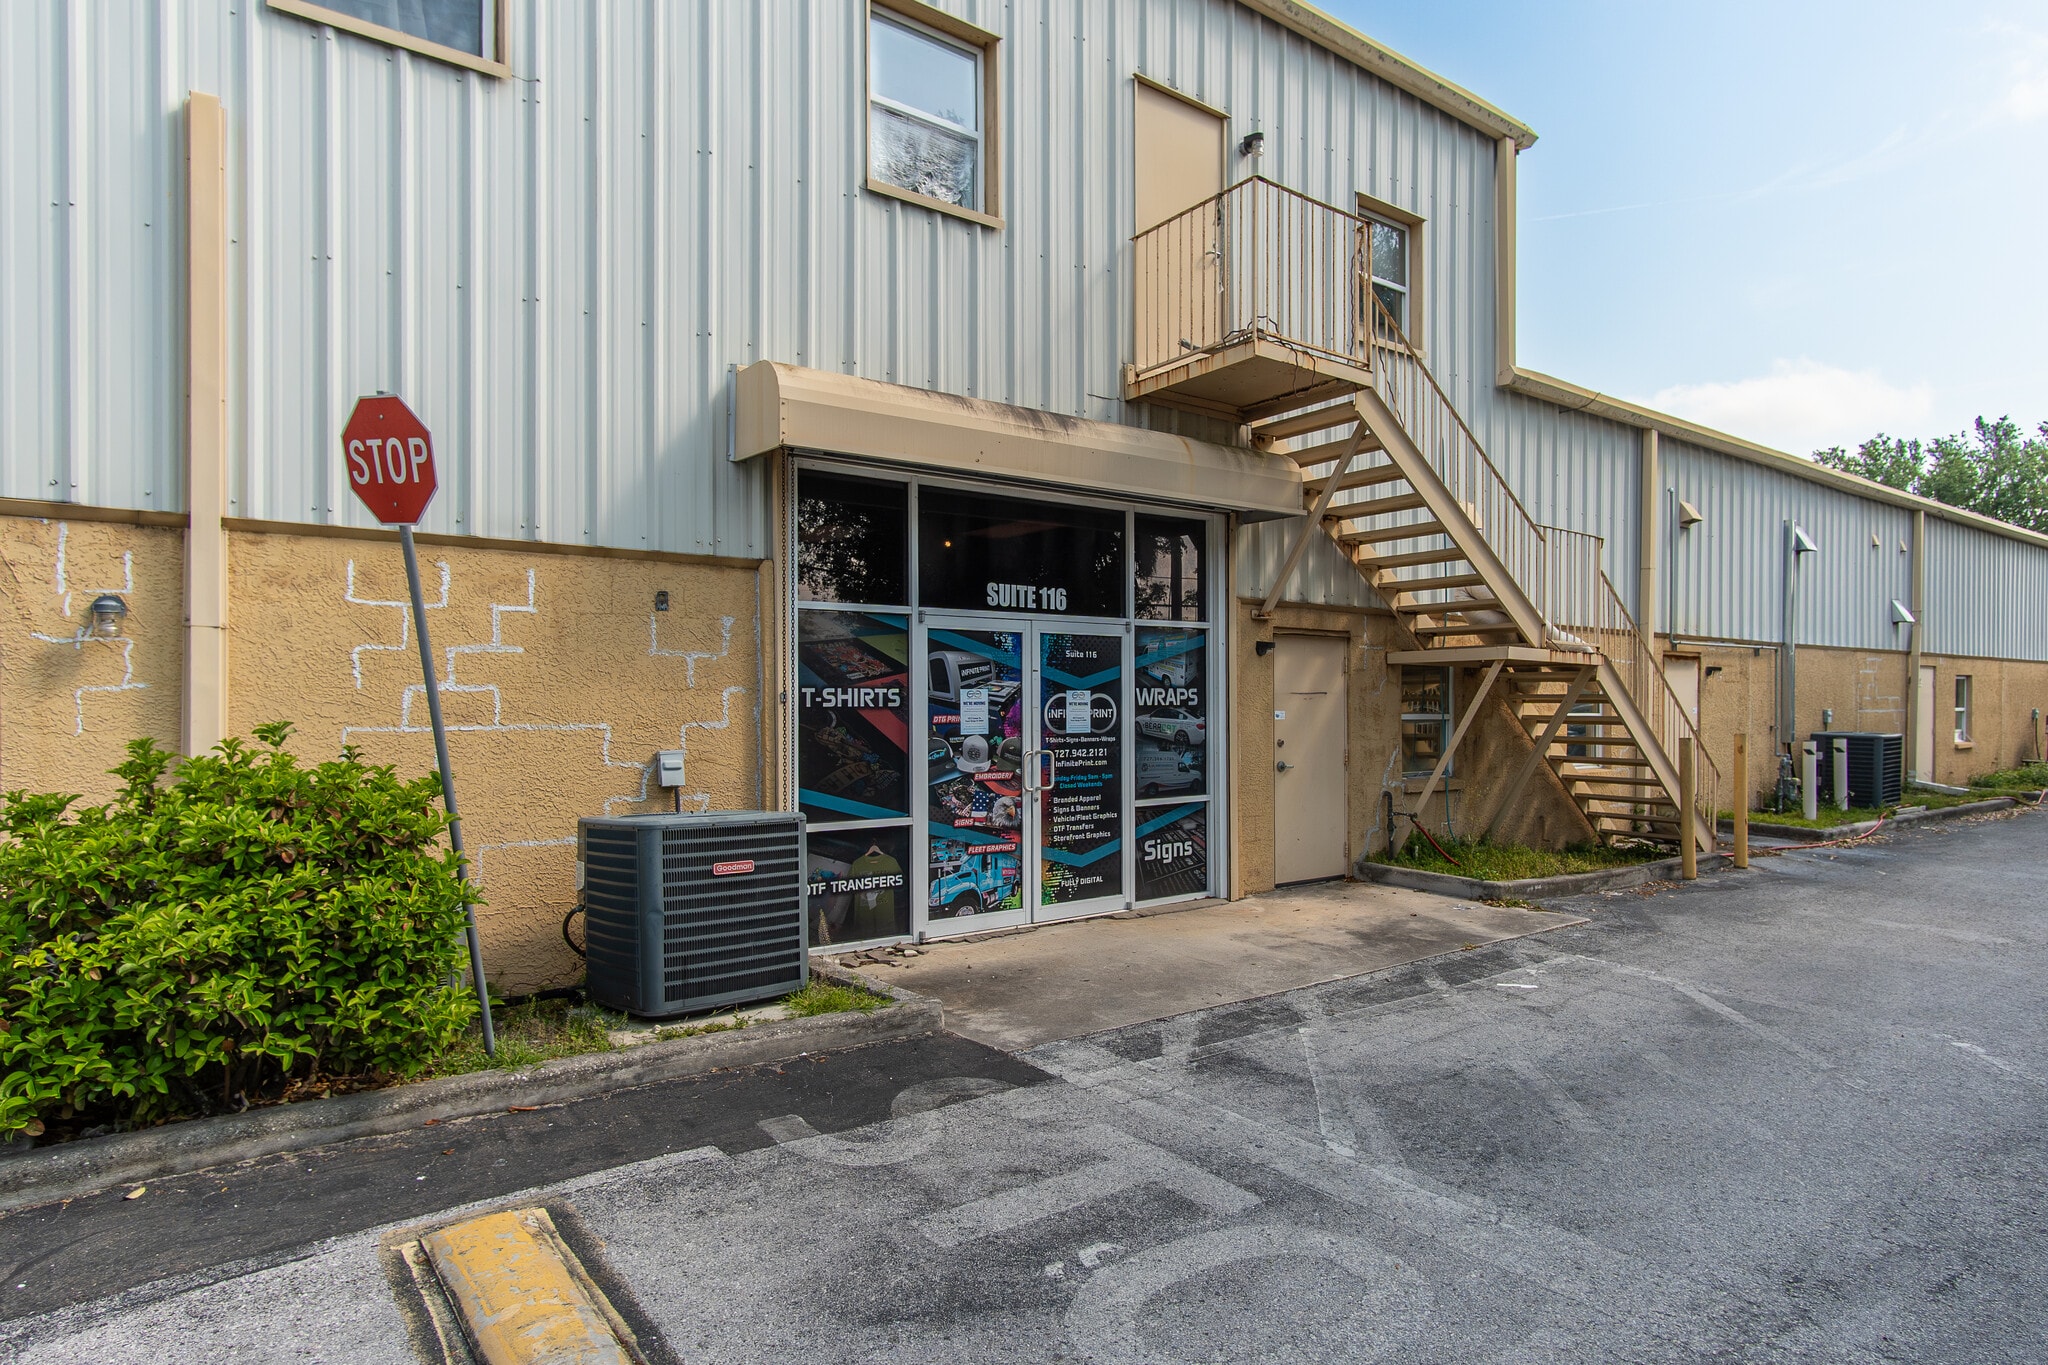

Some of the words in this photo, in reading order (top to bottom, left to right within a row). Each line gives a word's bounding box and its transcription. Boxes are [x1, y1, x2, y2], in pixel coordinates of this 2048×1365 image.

[349, 437, 428, 485] STOP
[986, 582, 1036, 609] SUITE
[1039, 587, 1067, 611] 116
[1066, 650, 1084, 658] Suite
[1086, 651, 1097, 659] 116
[801, 687, 901, 708] T-SHIRTS
[1136, 687, 1198, 706] WRAPS
[933, 715, 946, 724] DTG
[1054, 748, 1108, 758] 727.942.2121
[1055, 760, 1108, 768] InfinitePrint.com
[975, 772, 1013, 780] EMBROIDERY
[1053, 796, 1078, 804] Branded
[1079, 794, 1102, 803] Apparel
[1053, 806, 1070, 814] Signs
[954, 818, 974, 826] SIGNS
[1053, 813, 1092, 823] Vehicle/Fleet
[1092, 811, 1118, 820] Graphics
[1066, 823, 1095, 831] Transfers
[1053, 833, 1085, 842] Storefront
[1086, 830, 1111, 839] Graphics
[968, 845, 986, 854] FLEET
[986, 843, 1016, 852] GRAPHICS
[1144, 838, 1193, 864] Signs
[716, 863, 752, 872] Goodman
[830, 874, 903, 893] TRANSFERS
[1061, 877, 1079, 887] FULLY
[1080, 876, 1104, 885] DIGITAL
